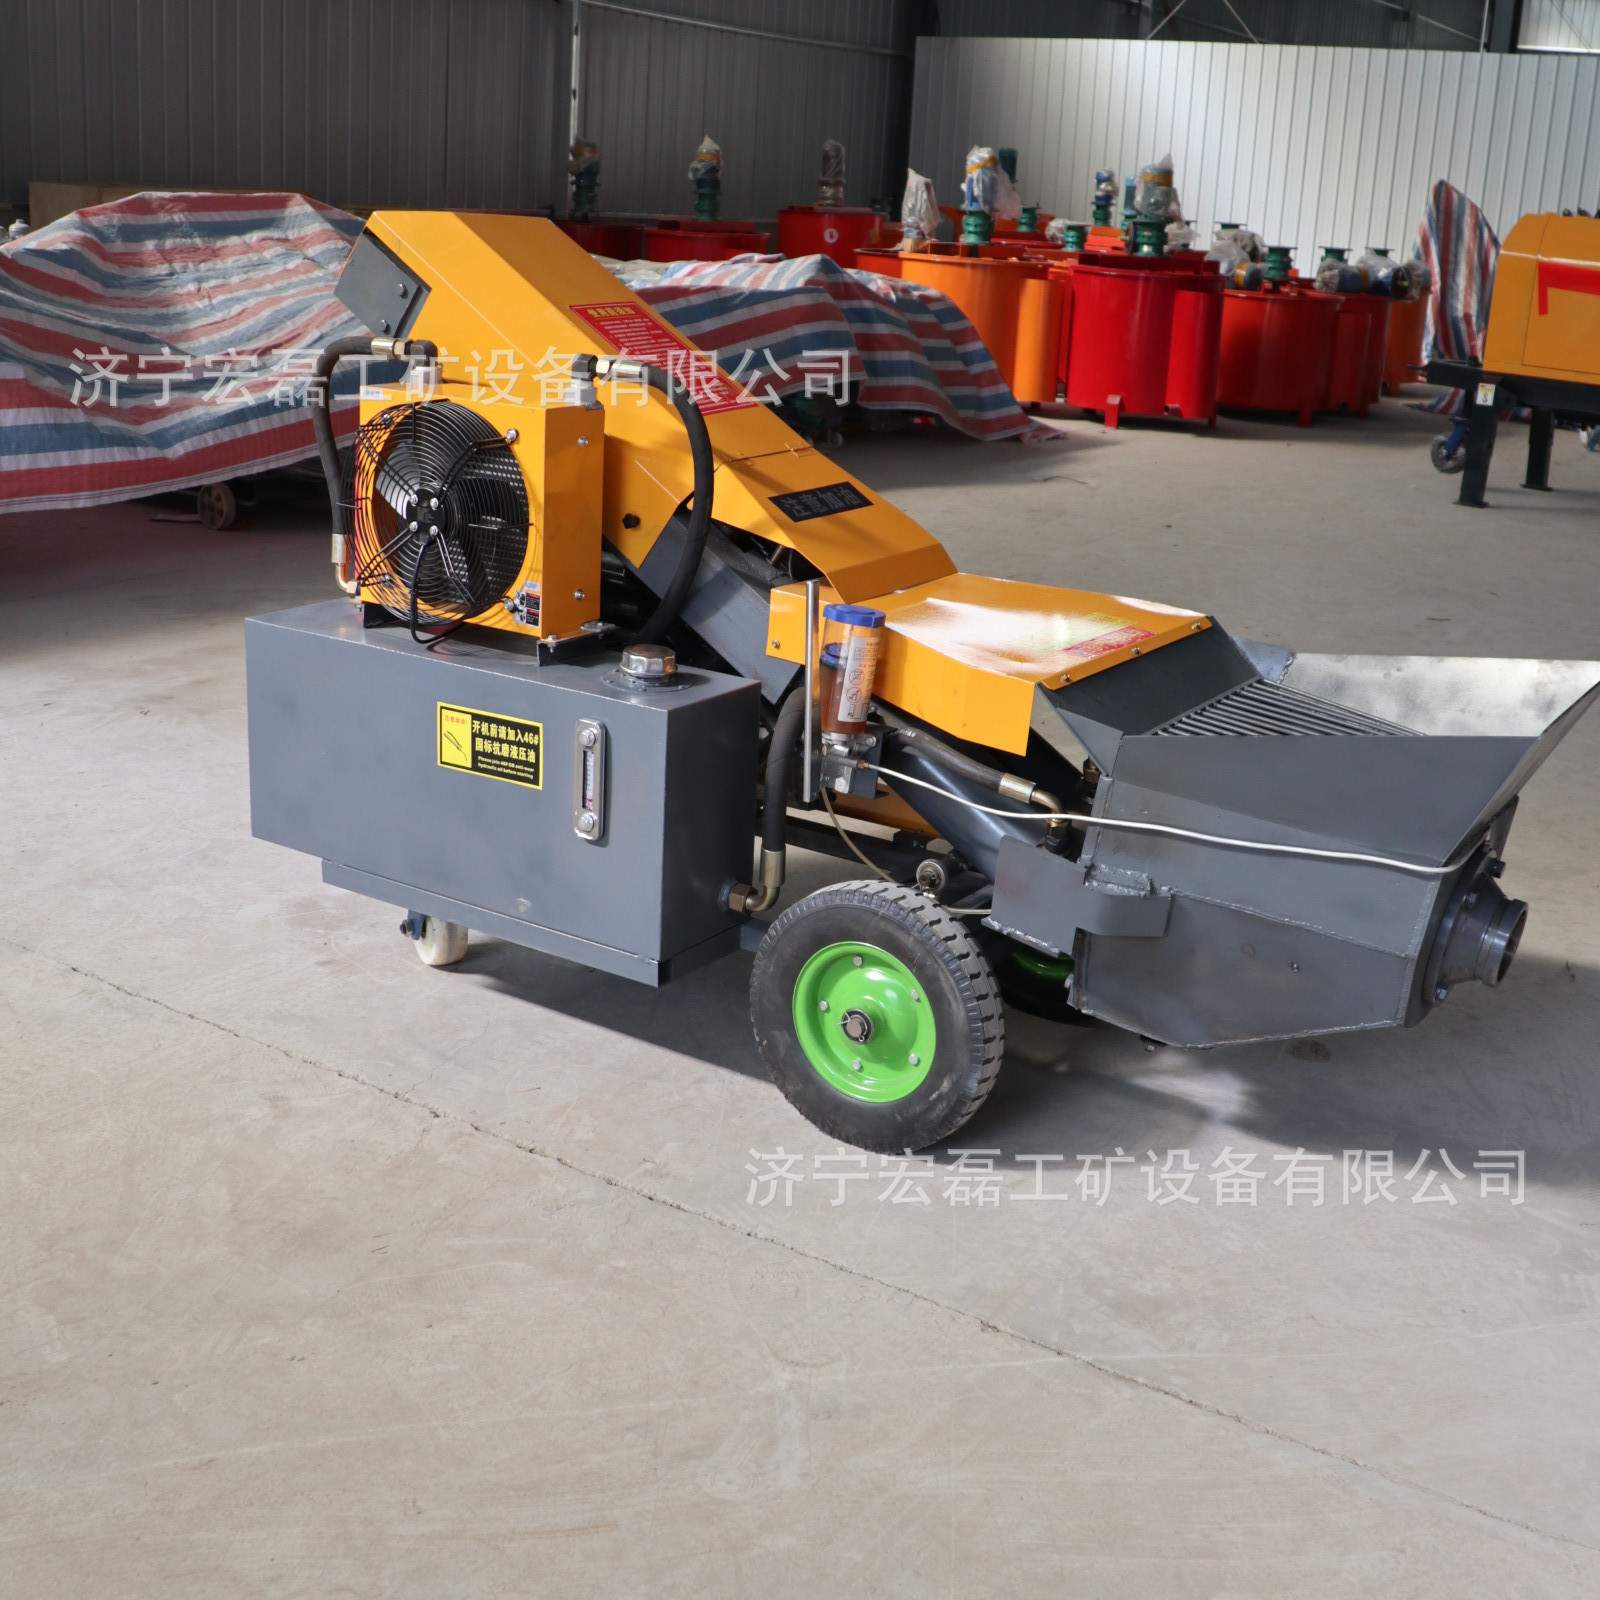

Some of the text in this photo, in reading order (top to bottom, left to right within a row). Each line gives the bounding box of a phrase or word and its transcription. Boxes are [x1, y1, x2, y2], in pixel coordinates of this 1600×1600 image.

[475, 737, 536, 763] 国标抗磨液压油
